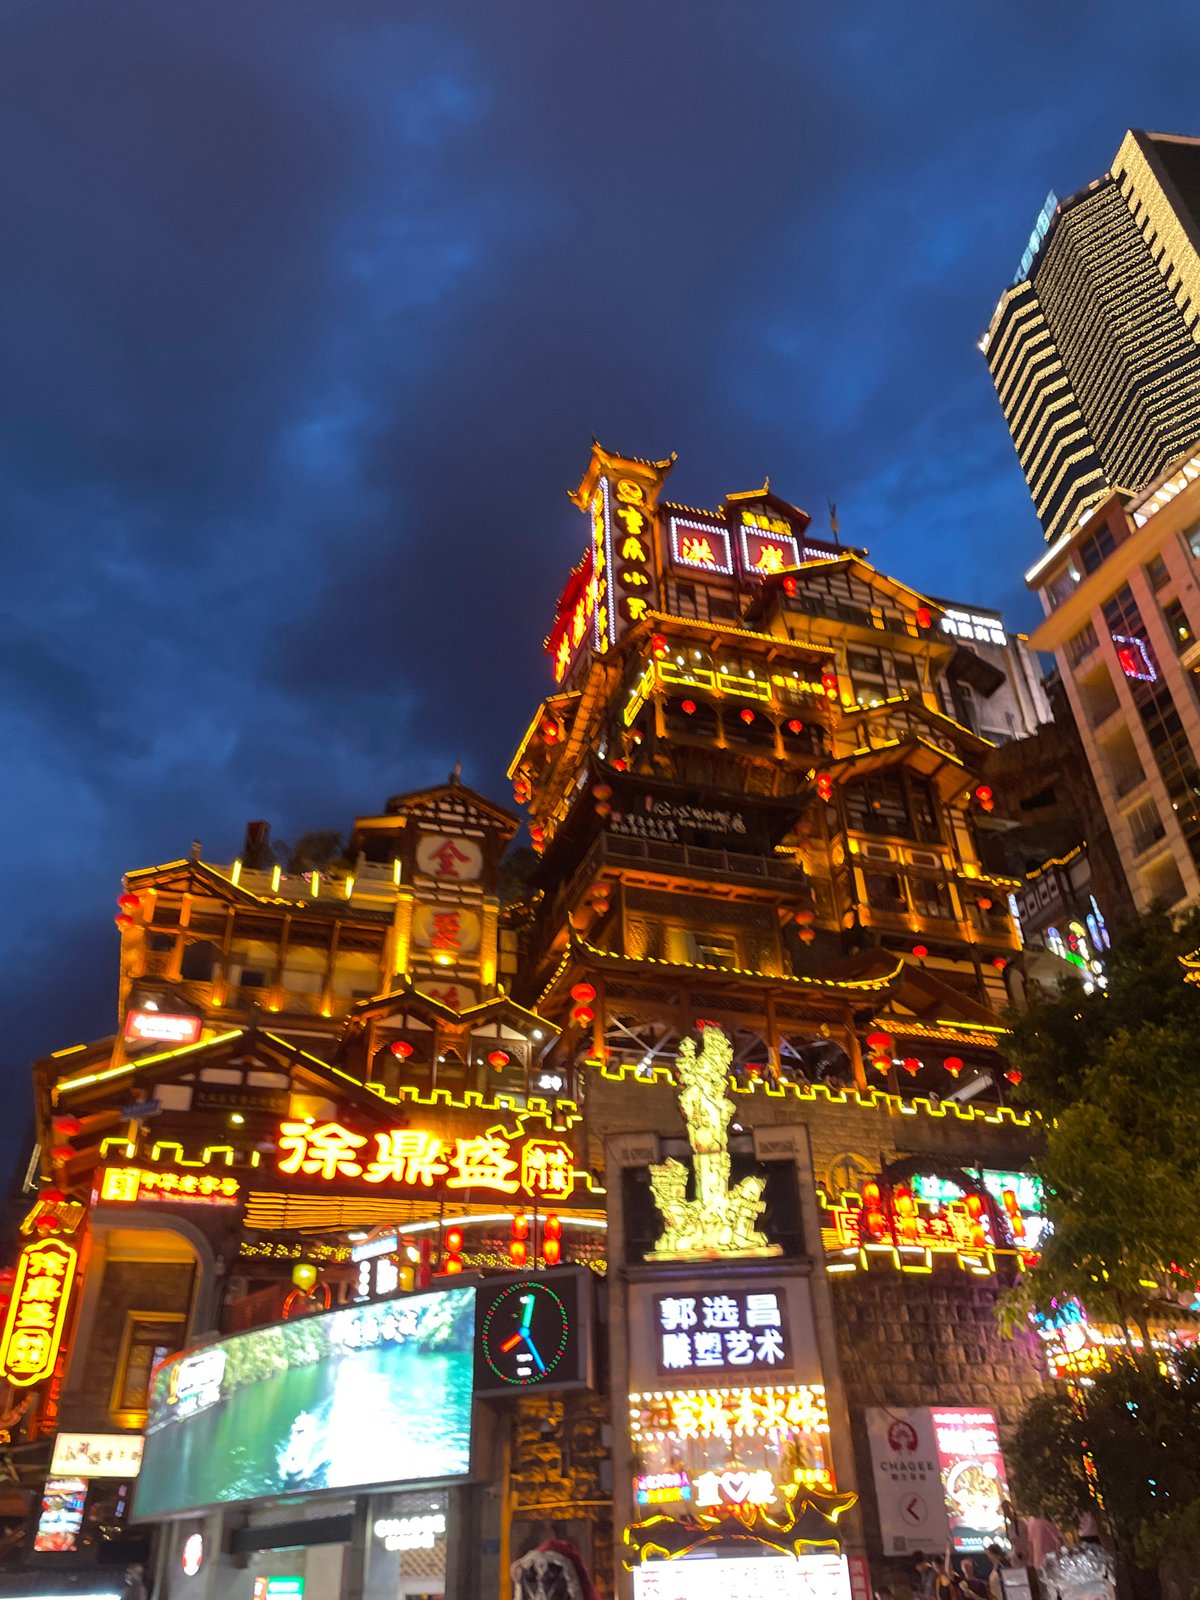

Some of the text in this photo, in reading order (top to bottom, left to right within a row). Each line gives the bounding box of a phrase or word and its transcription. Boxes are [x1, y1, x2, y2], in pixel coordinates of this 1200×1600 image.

[278, 1121, 521, 1194] 徐鼎盛
[660, 1293, 782, 1331] 郭选昌
[662, 1328, 785, 1369] 雕塑艺术
[879, 1460, 934, 1472] CHAGEE
